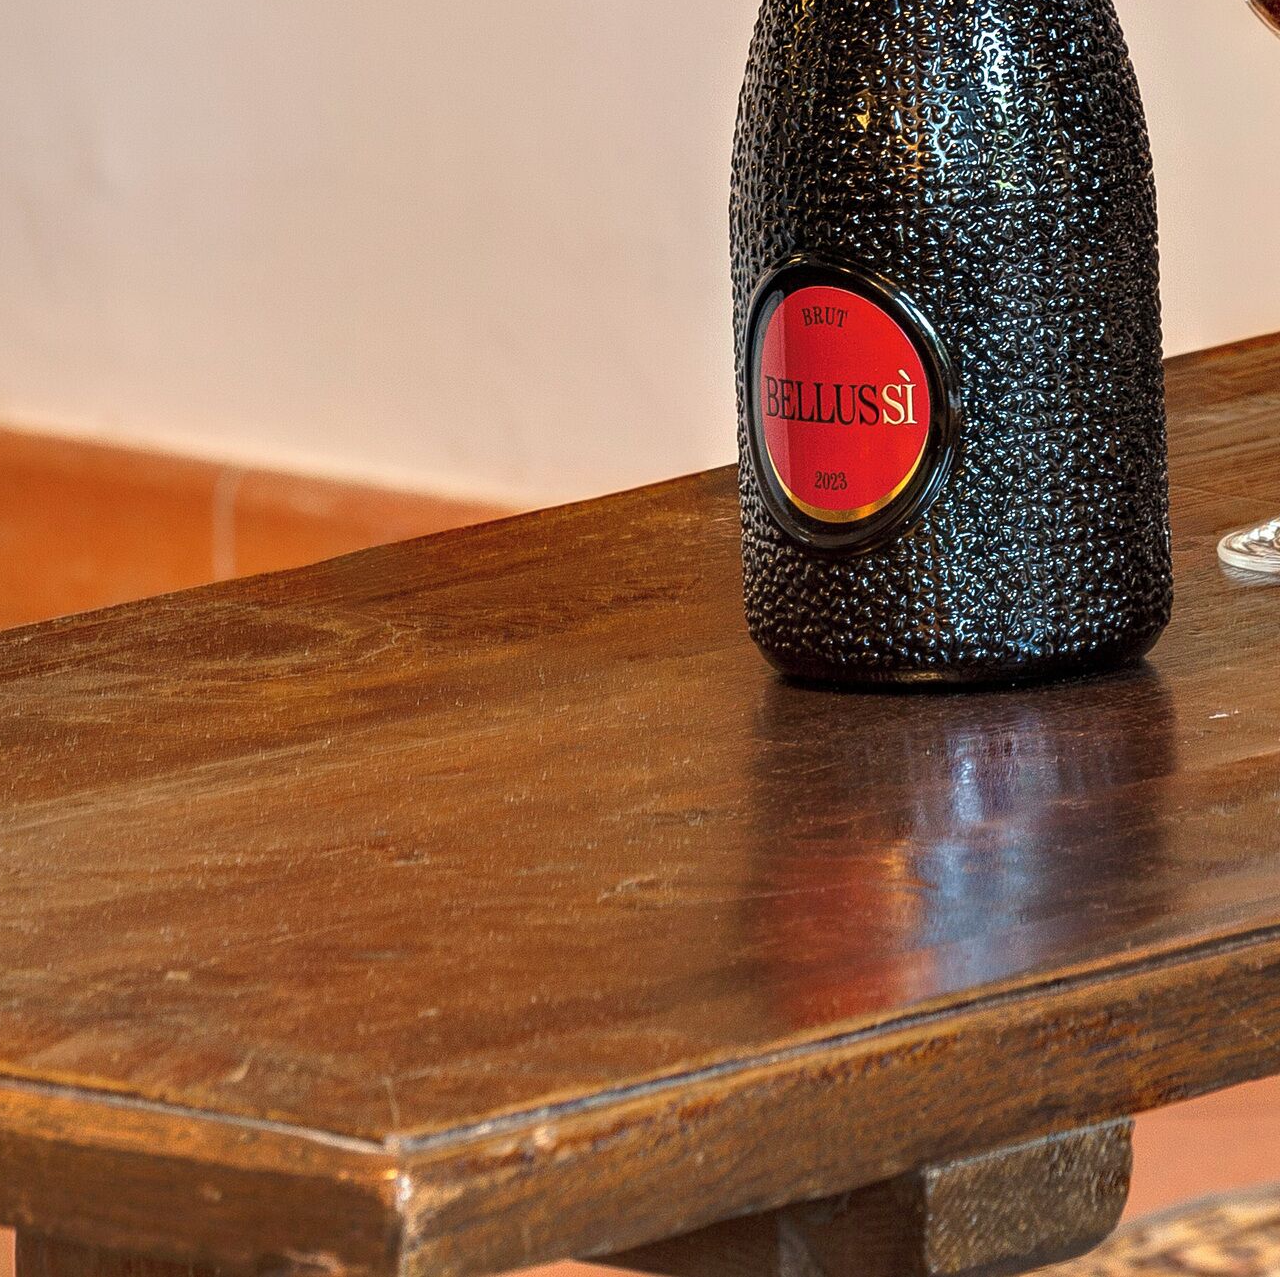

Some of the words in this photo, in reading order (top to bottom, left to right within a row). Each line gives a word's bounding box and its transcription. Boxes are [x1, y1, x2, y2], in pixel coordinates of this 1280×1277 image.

[802, 306, 848, 328] BRUT
[765, 369, 918, 426] BELLUSSÌ
[814, 470, 848, 490] 2023
